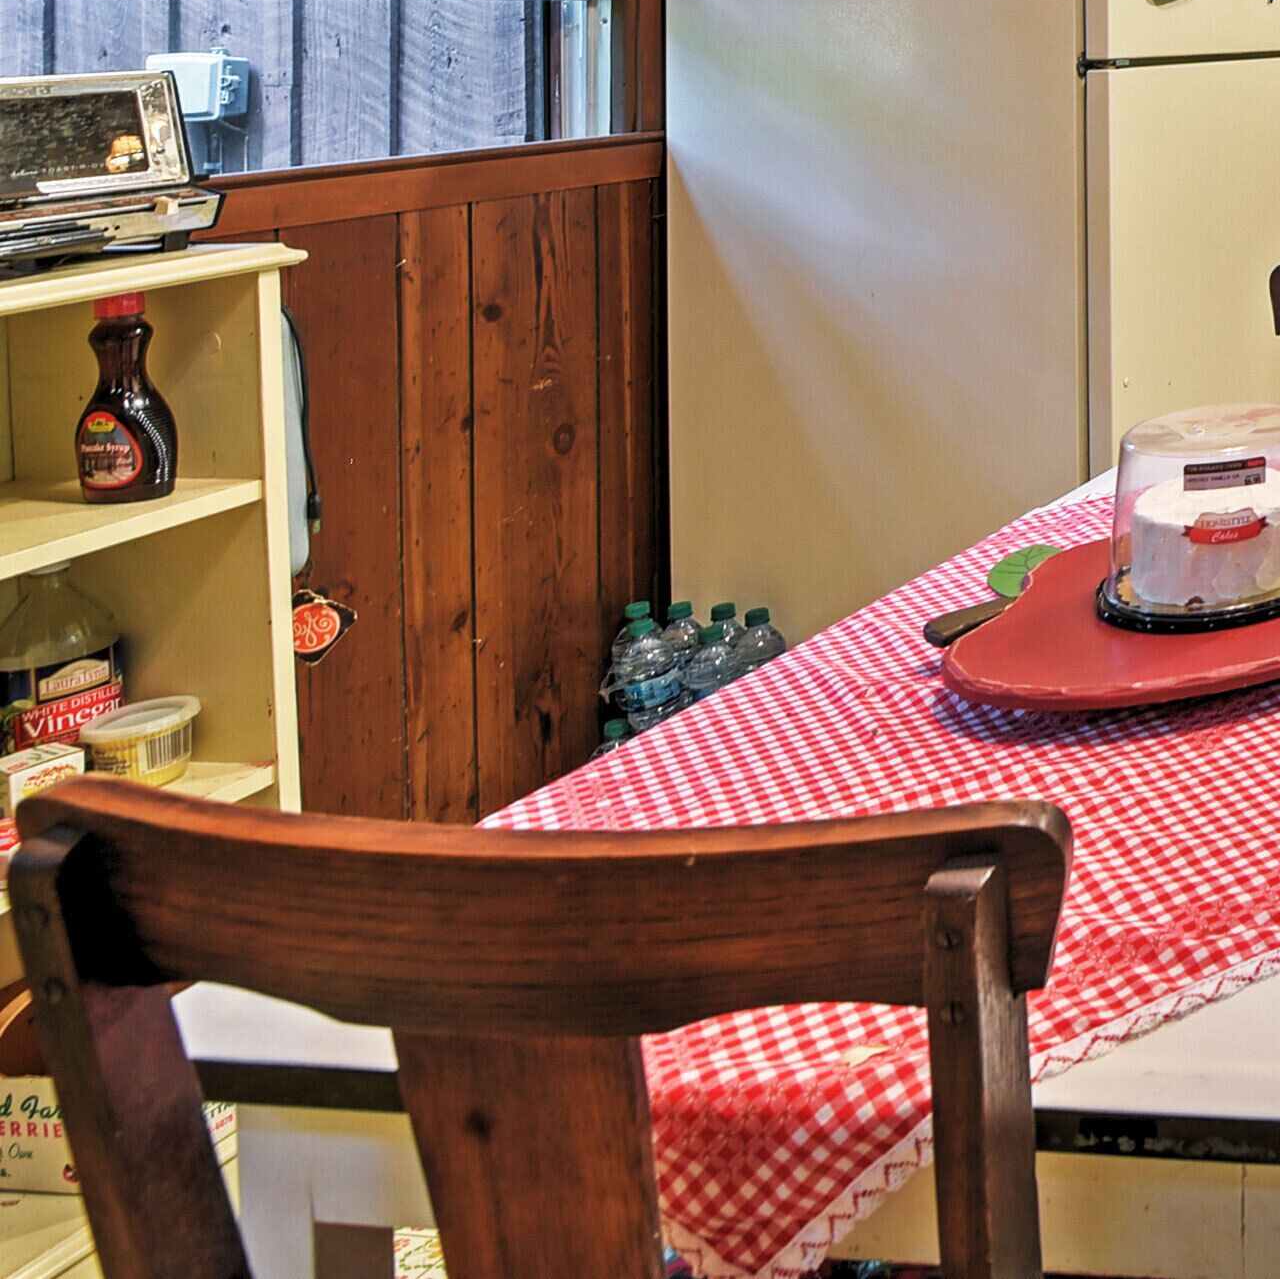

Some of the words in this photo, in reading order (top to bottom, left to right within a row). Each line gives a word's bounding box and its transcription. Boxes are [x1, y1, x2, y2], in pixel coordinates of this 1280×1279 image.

[106, 442, 131, 455] Syrup
[21, 699, 69, 722] WHITE
[23, 696, 121, 739] Vinegar
